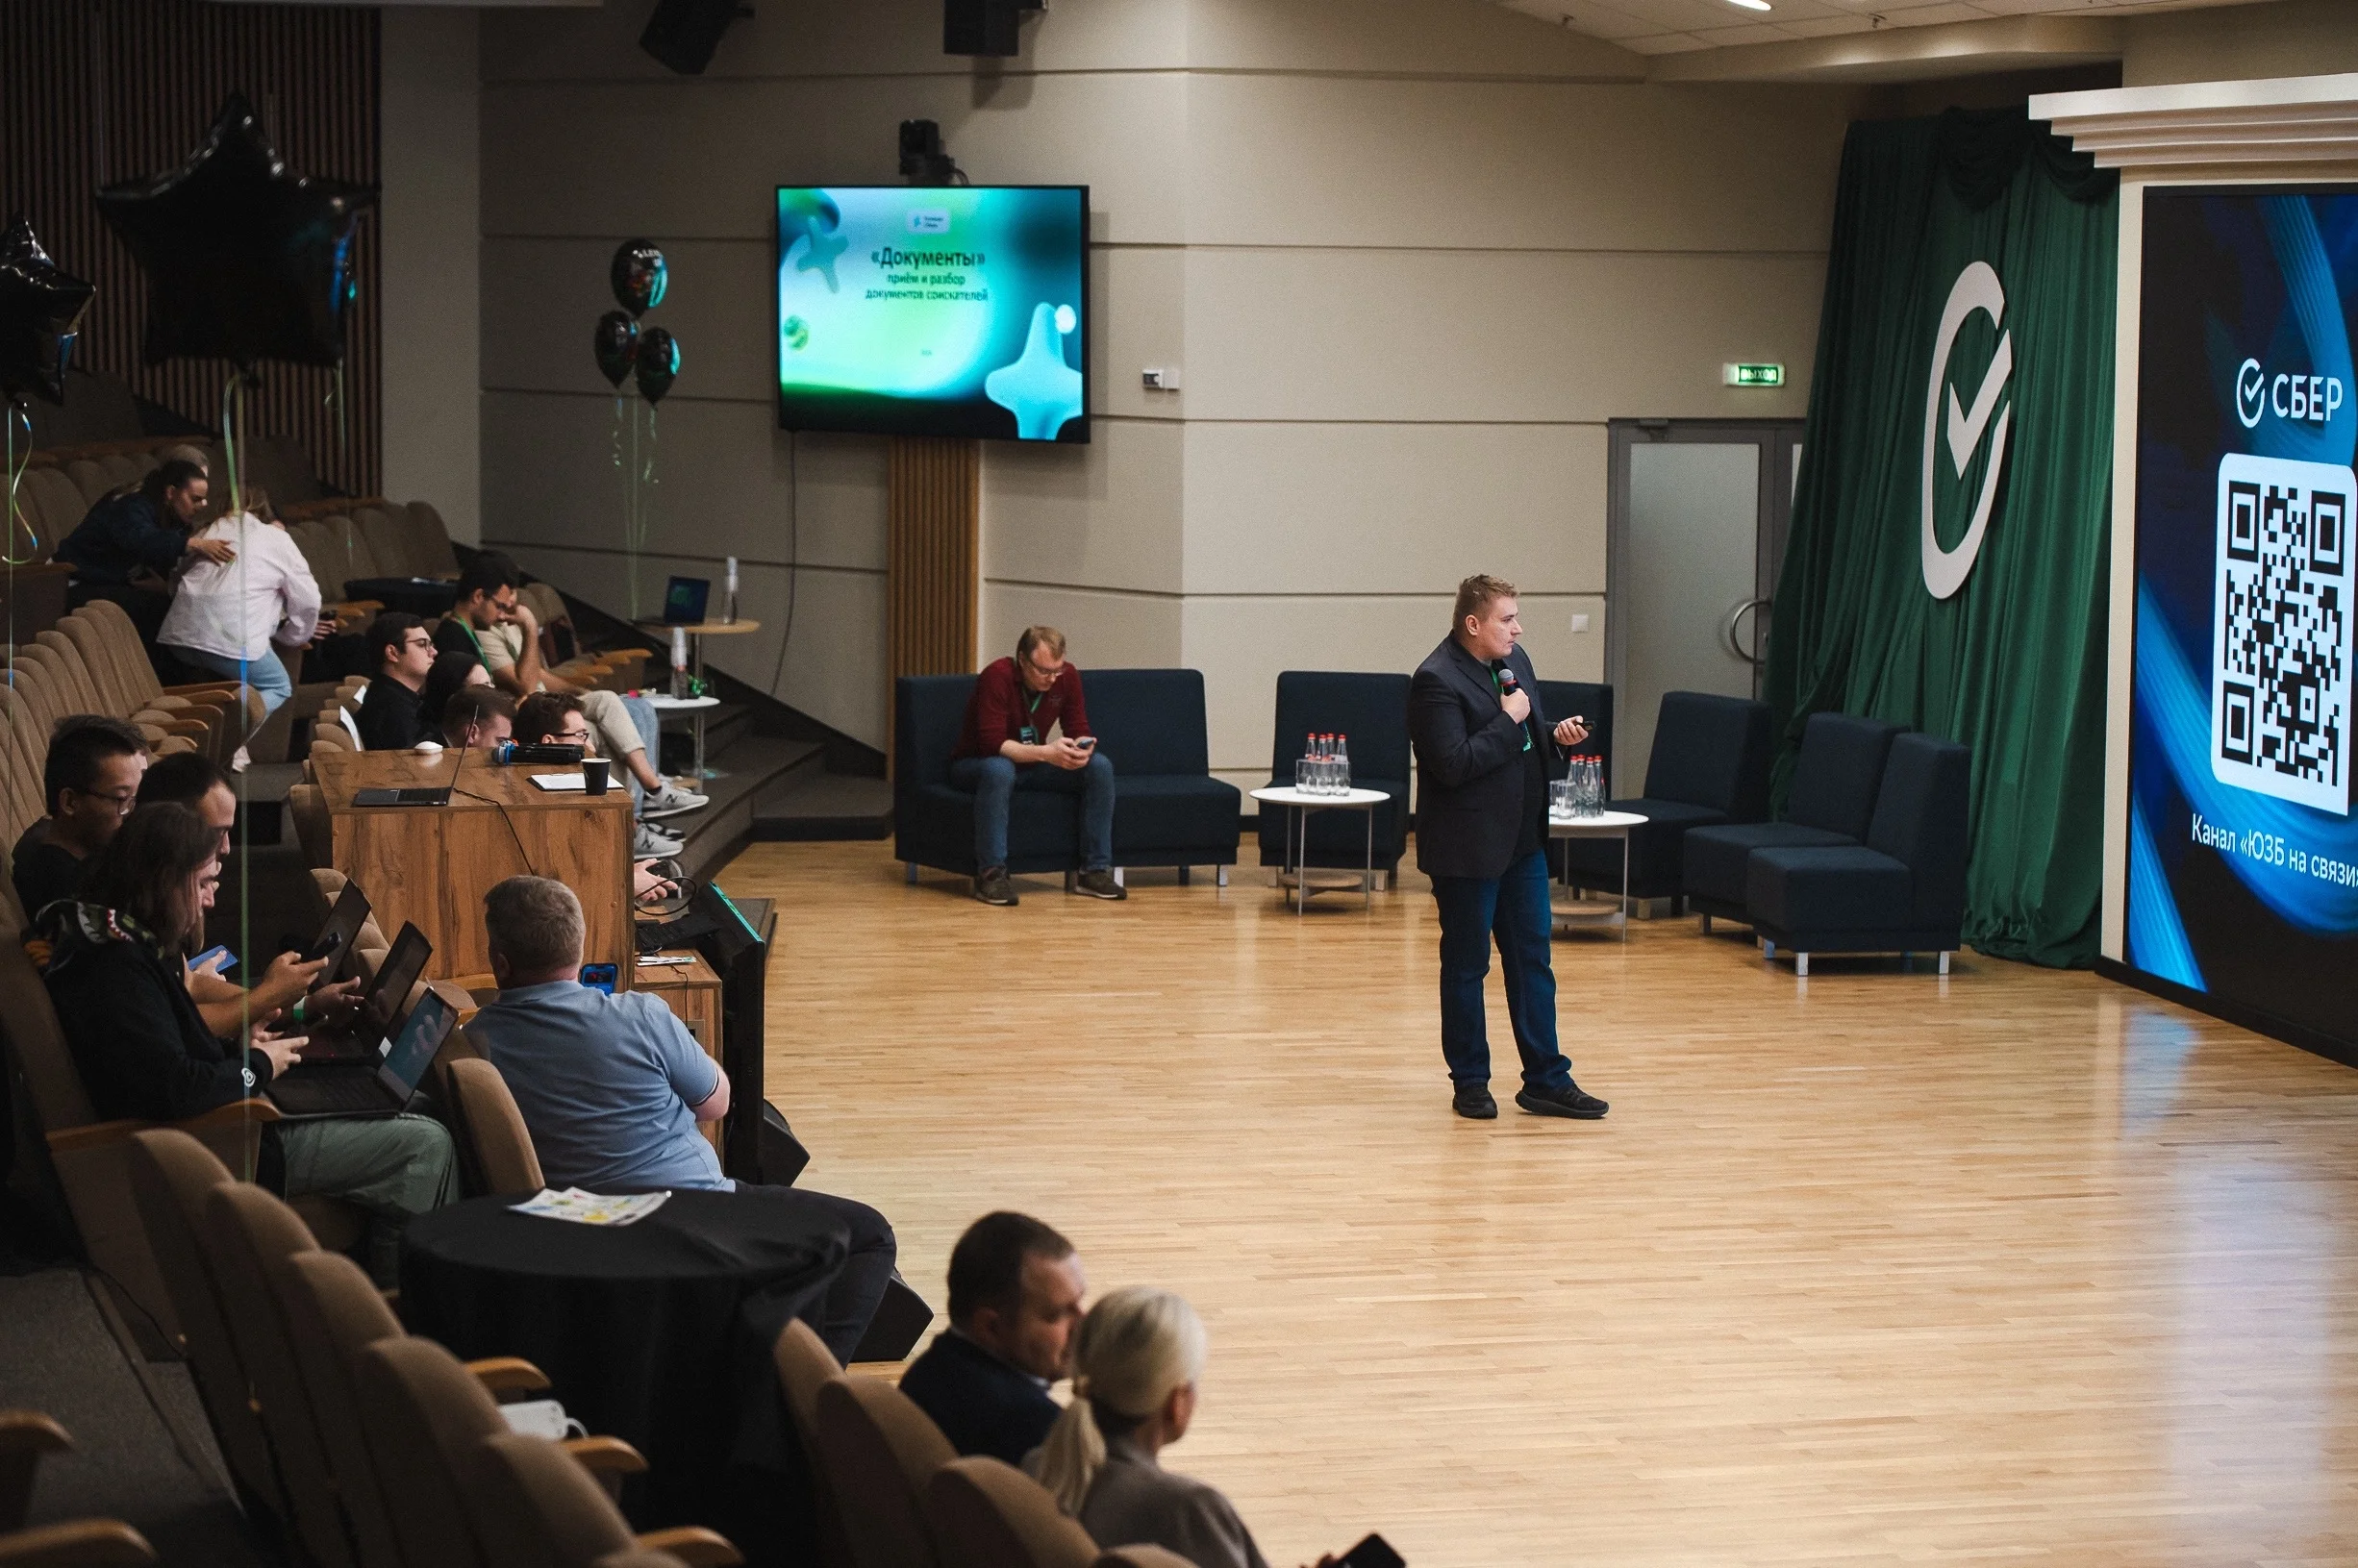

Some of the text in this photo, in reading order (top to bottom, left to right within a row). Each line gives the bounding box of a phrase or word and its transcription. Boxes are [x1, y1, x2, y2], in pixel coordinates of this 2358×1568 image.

[871, 246, 986, 270] «Документы»
[2271, 373, 2344, 422] СБЕР
[2192, 813, 2236, 854] Канал
[2240, 829, 2285, 866] «ЮЗБ
[2289, 848, 2307, 874] на
